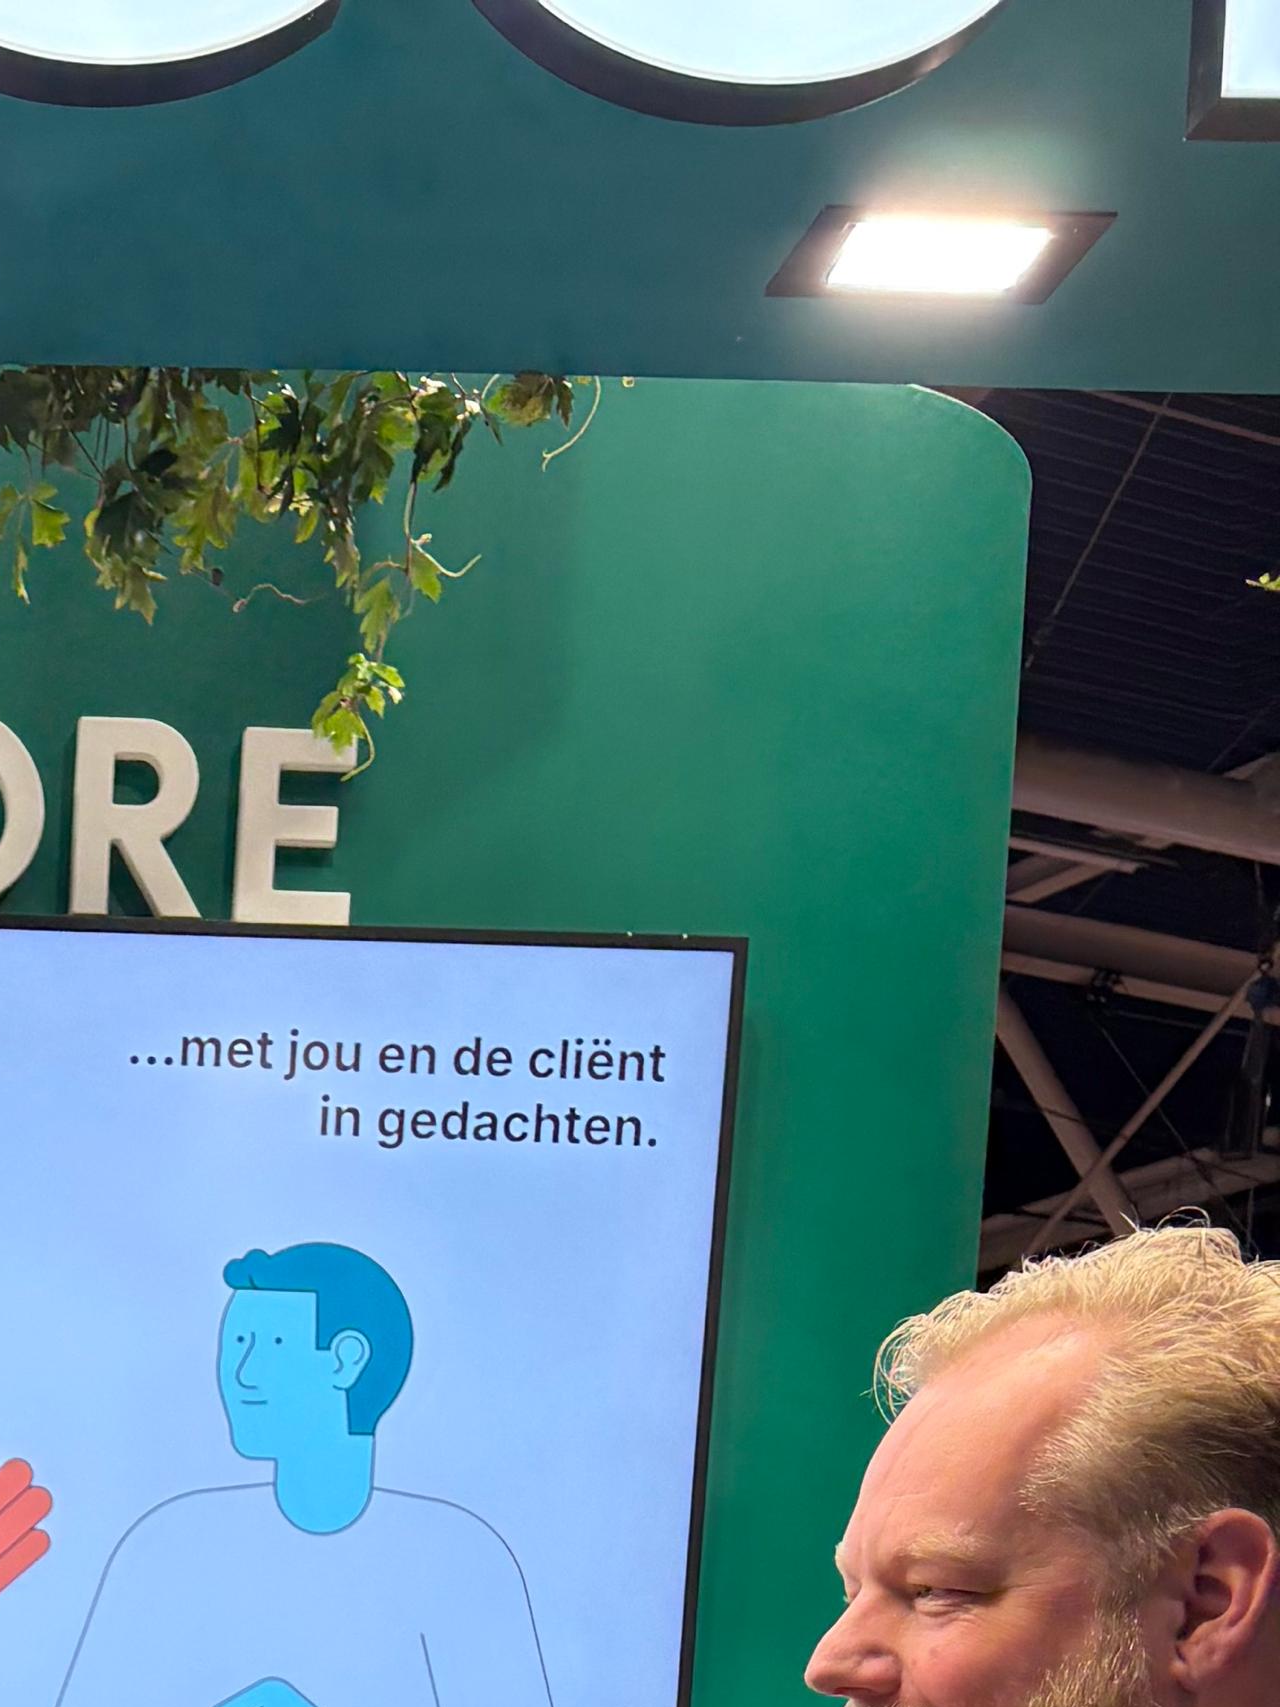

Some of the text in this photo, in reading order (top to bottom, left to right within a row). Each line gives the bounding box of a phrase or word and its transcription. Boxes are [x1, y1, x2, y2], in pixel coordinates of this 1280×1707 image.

[128, 1029, 666, 1084] ...met jou en de cliënt
[319, 1094, 659, 1149] in gedachten.
